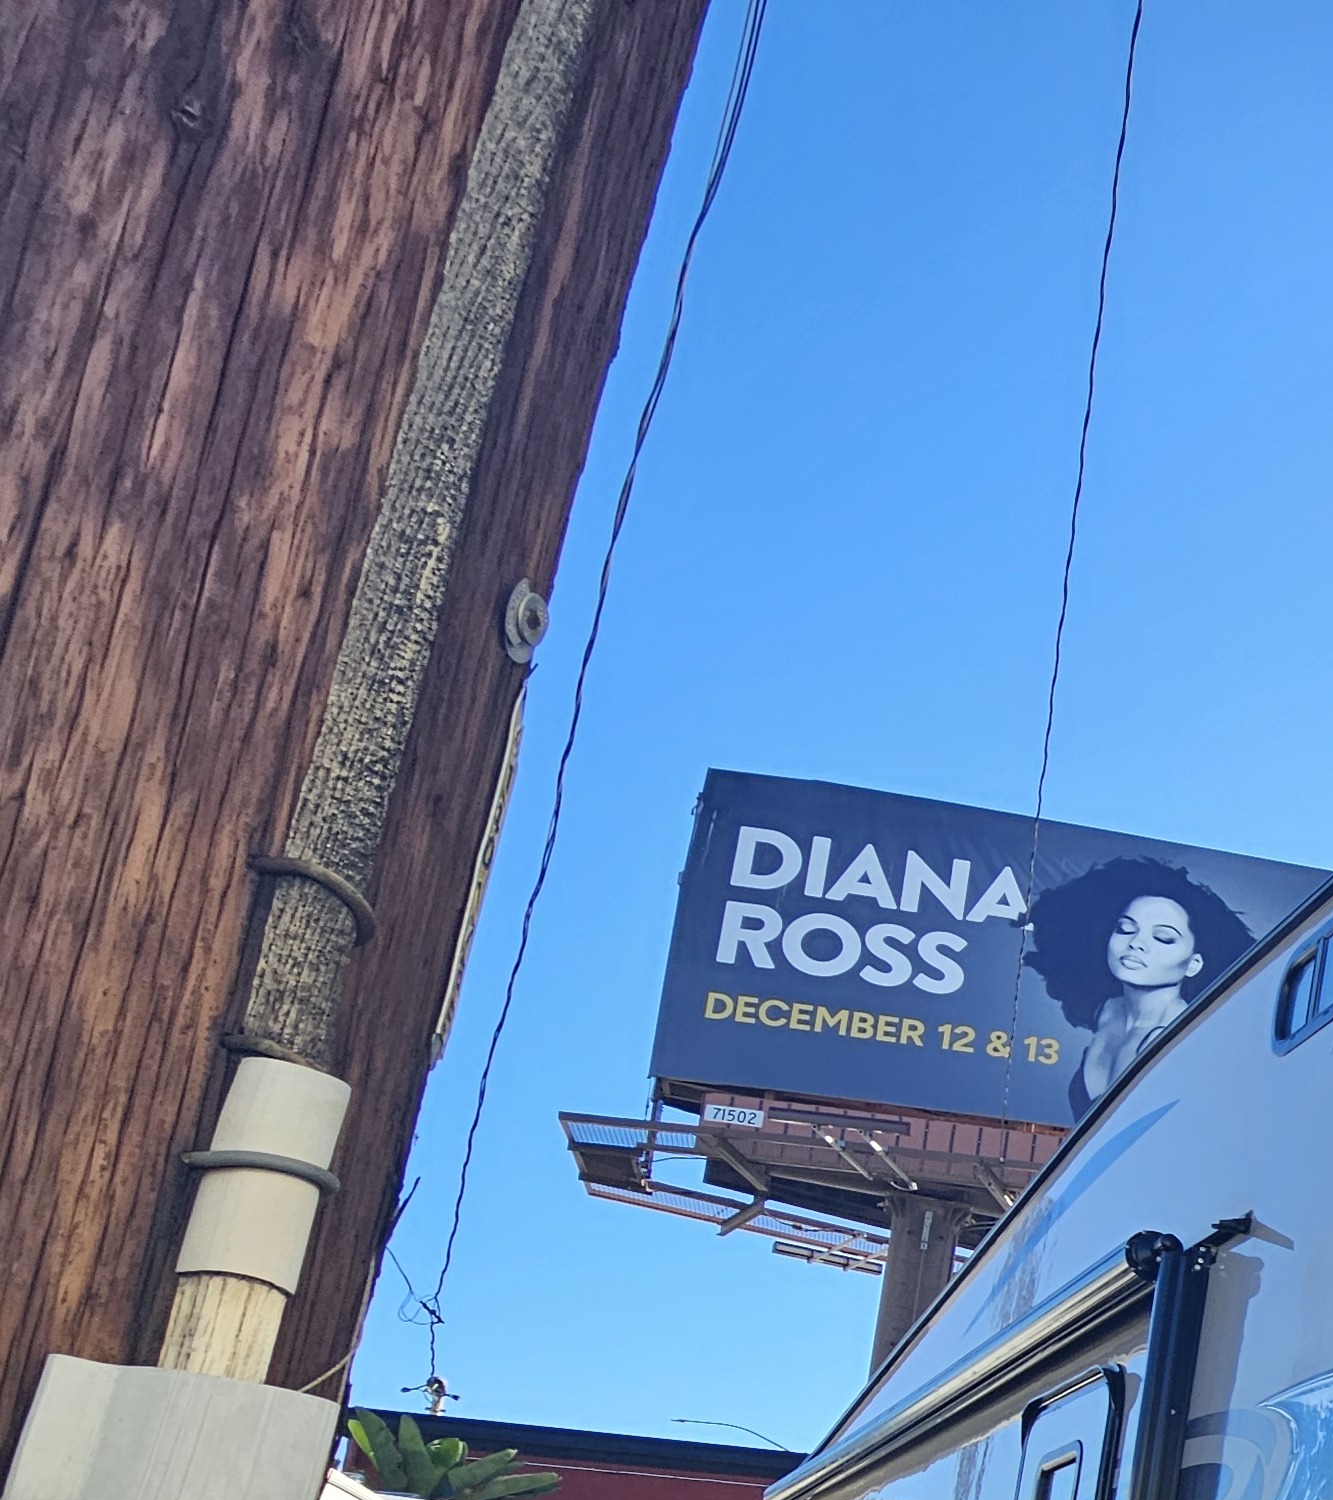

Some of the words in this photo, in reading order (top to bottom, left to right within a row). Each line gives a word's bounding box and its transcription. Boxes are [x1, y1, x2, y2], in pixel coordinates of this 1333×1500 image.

[730, 825, 1034, 931] DIANA
[716, 901, 968, 994] ROSS
[704, 992, 925, 1046] DECEMBER
[938, 1024, 975, 1053] 12
[986, 1031, 1011, 1058] &
[1024, 1036, 1060, 1064] 13
[713, 1107, 757, 1125] 71502
